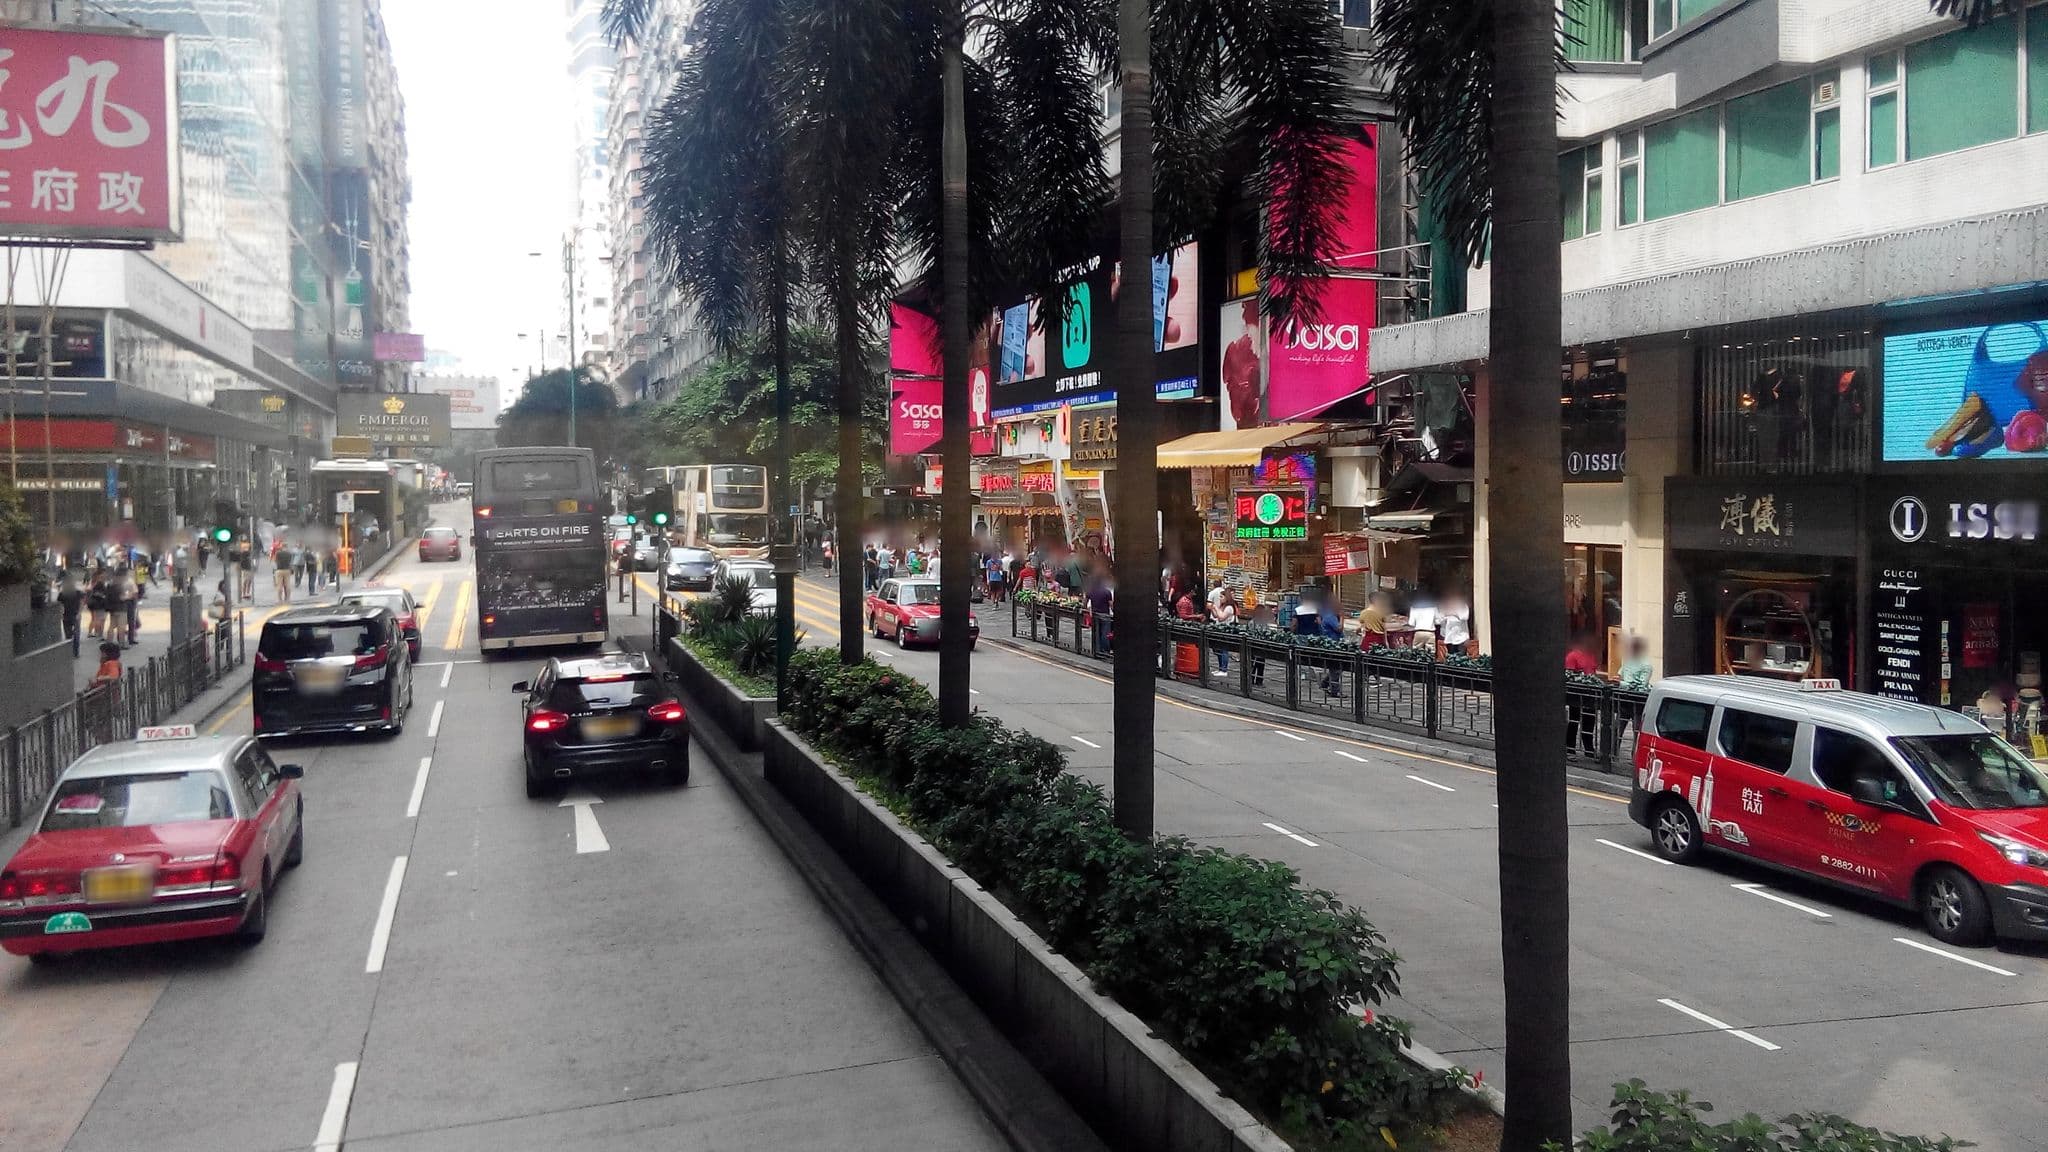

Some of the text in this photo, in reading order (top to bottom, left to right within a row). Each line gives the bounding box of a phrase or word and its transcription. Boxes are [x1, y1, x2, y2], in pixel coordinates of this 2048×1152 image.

[358, 415, 430, 425] EMPEROR
[1584, 453, 1617, 471] ISSI
[540, 527, 560, 537] ON
[562, 525, 590, 536] FIRE
[1883, 569, 1917, 579] GUCCI
[1878, 622, 1921, 631] BALENCIAGA
[1887, 657, 1911, 668] FENDI
[1812, 680, 1835, 689] TAXI
[1884, 680, 1914, 692] PRADA
[143, 726, 191, 738] TAXI
[1742, 787, 1763, 803] 的士
[1742, 799, 1763, 815] TAXI
[1831, 857, 1877, 878] 2882 4111
